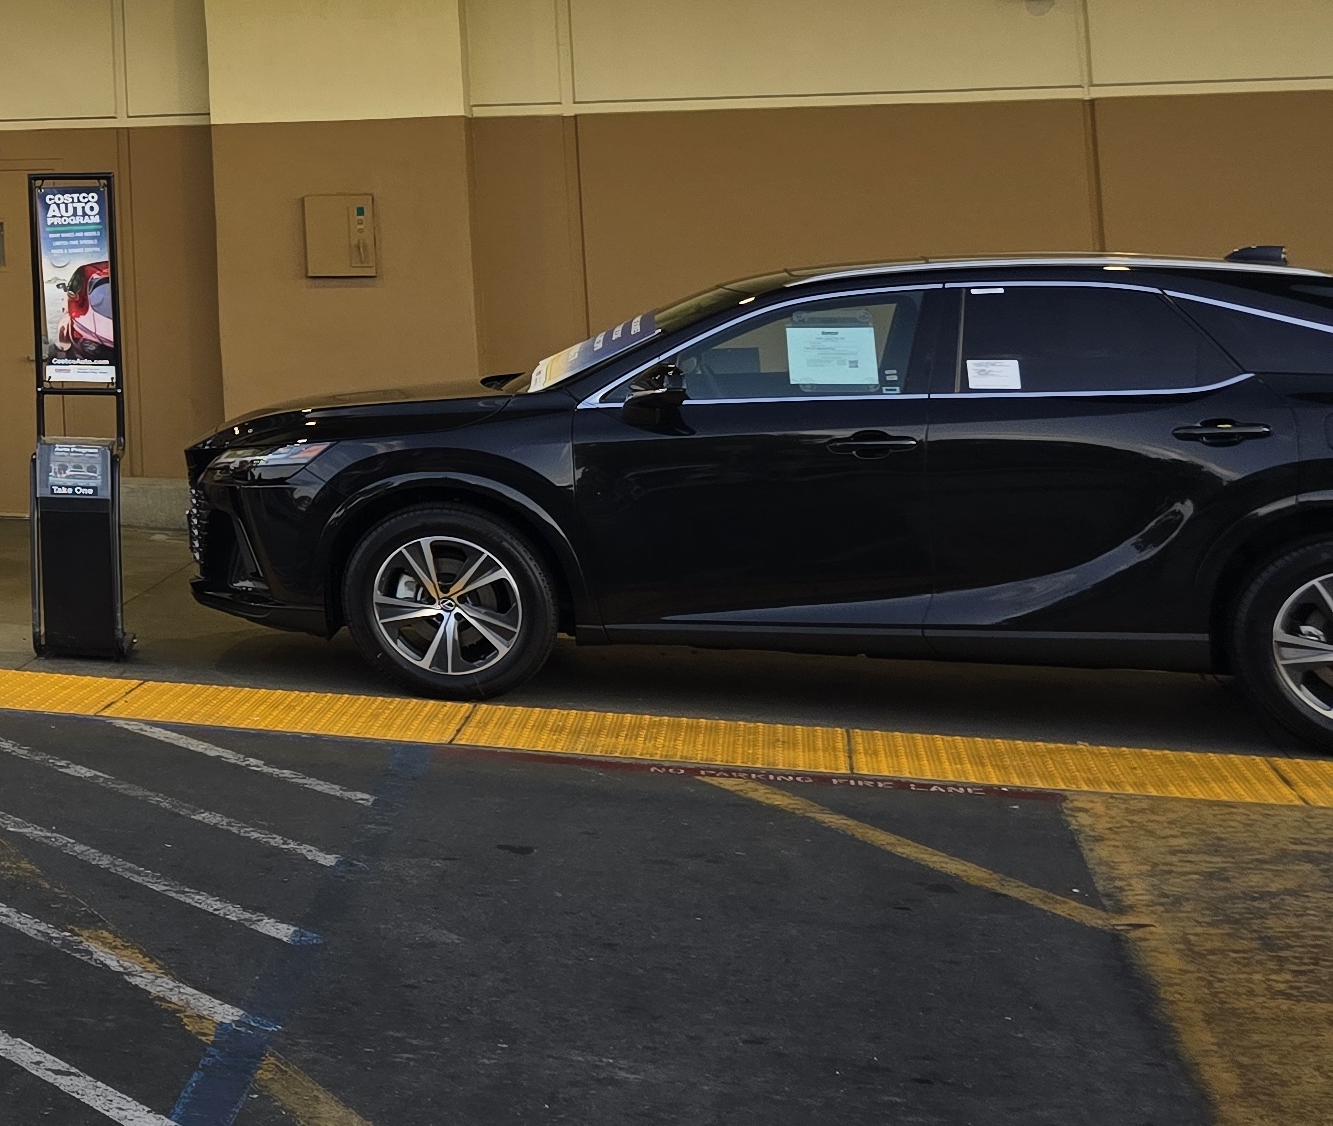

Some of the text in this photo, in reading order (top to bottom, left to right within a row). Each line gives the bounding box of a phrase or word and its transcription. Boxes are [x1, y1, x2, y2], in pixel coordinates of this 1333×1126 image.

[45, 192, 99, 204] COSTCO
[47, 202, 99, 217] AUTO
[47, 216, 101, 225] PROGRAM
[51, 486, 94, 494] Take One
[650, 766, 986, 796] NO PARKING FIRE LANE
